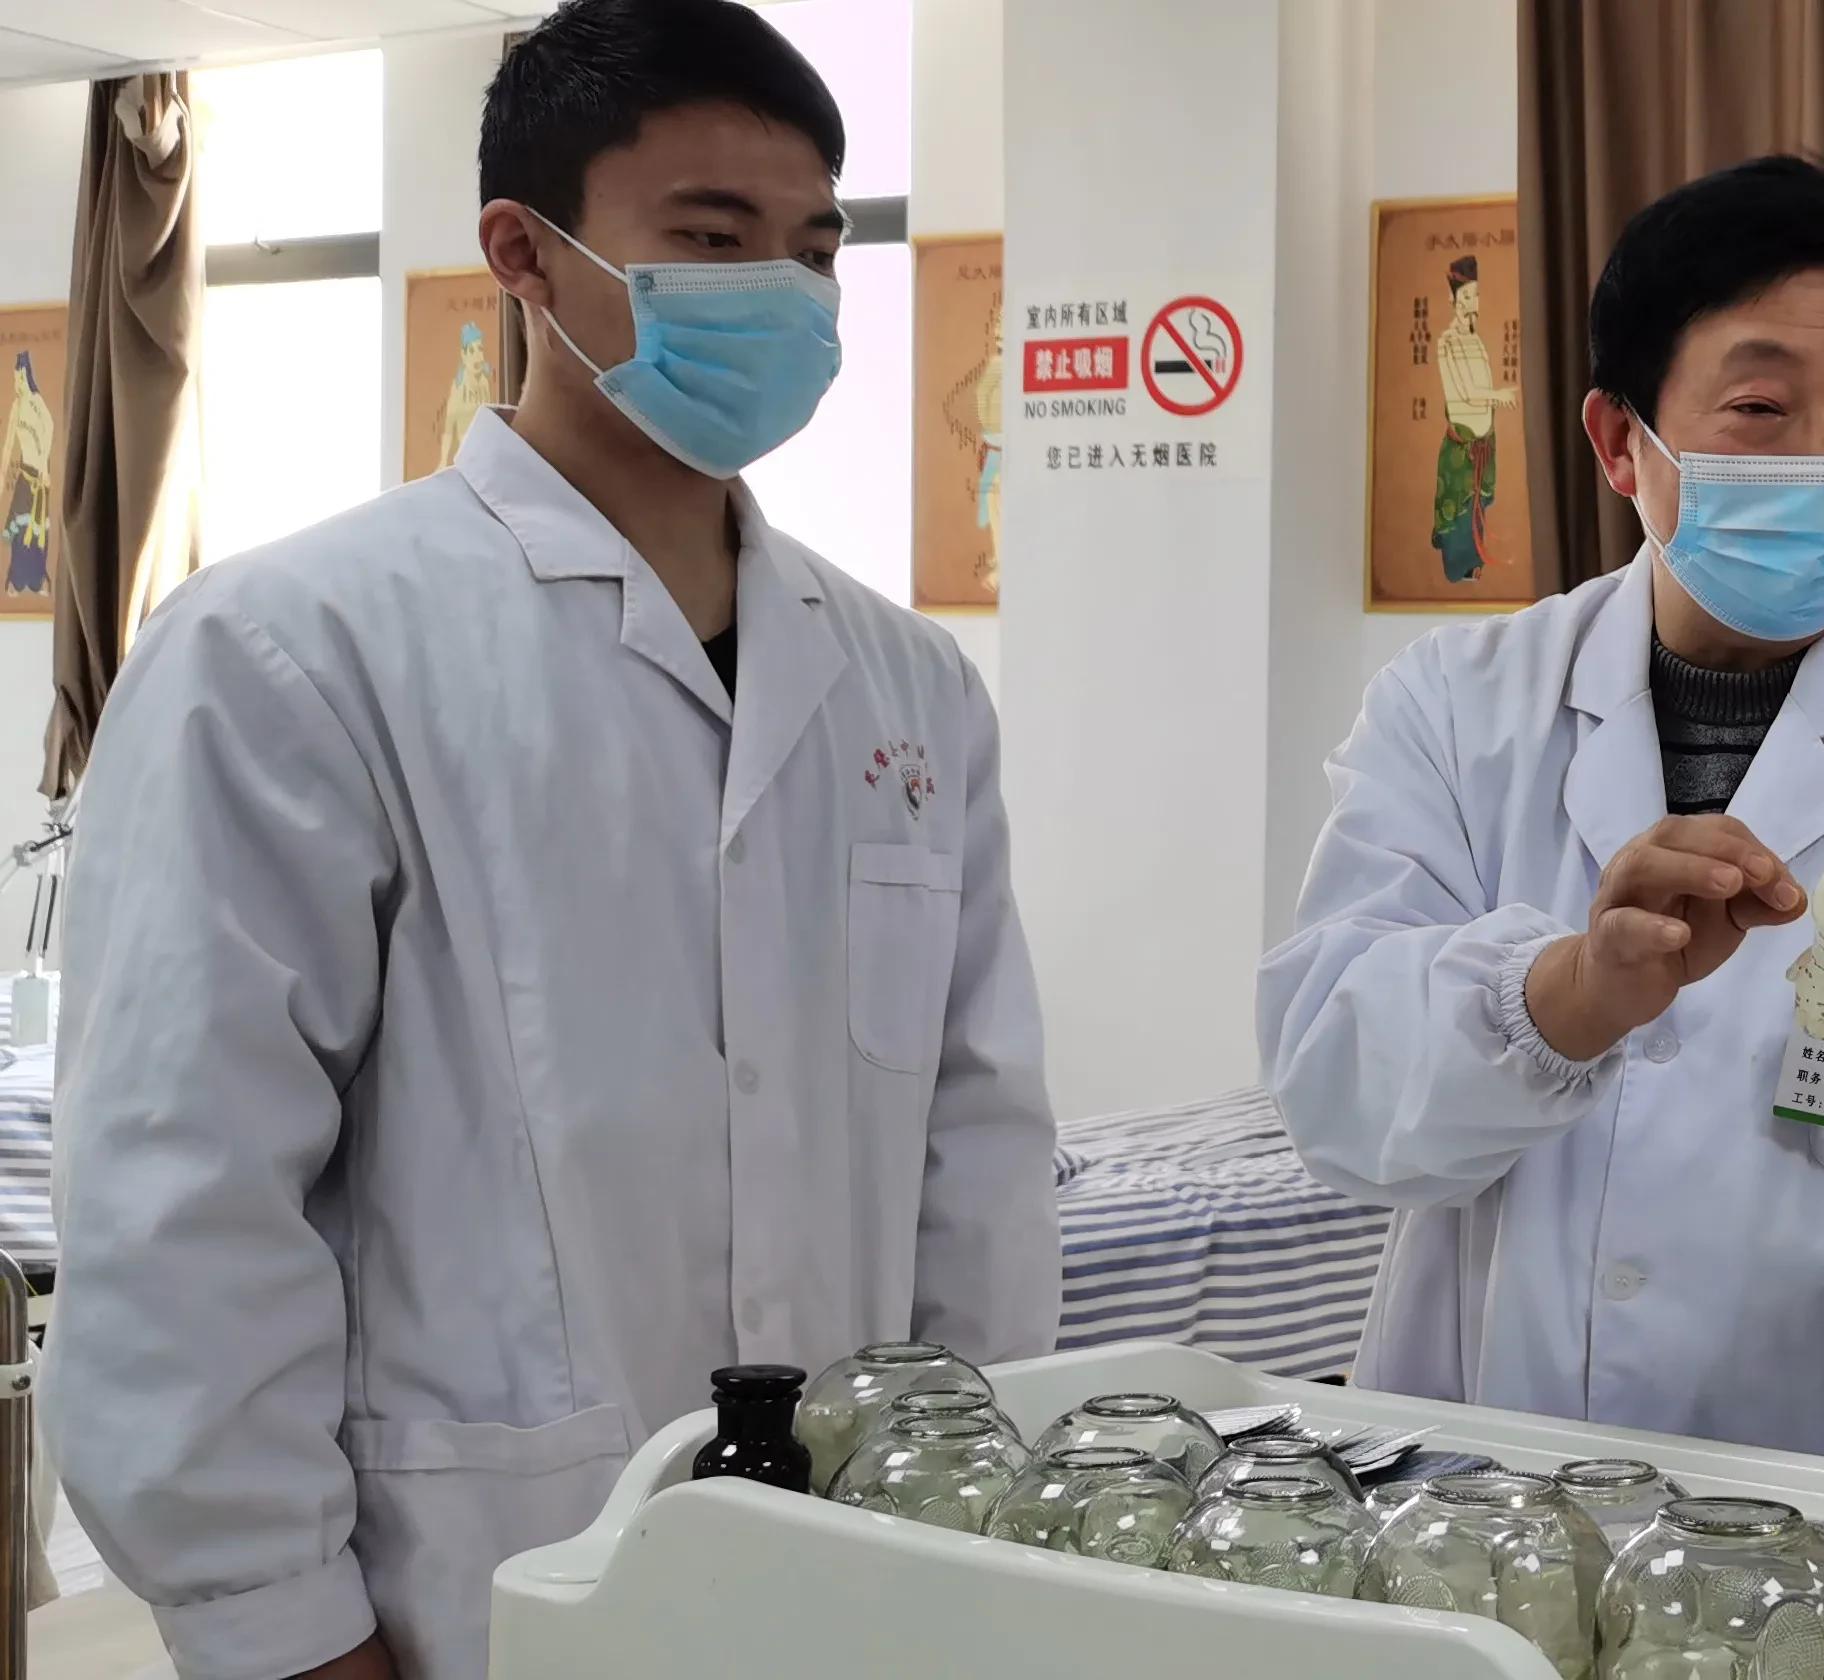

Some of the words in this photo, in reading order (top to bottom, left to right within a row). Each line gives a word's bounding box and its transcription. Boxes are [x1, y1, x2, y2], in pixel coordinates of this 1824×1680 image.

[1026, 301, 1128, 330] 室内所有区域
[1034, 346, 1114, 380] 禁止吸烟
[1024, 401, 1047, 419] NO
[1051, 398, 1127, 418] SMOKING
[1046, 442, 1218, 470] 您已进入无烟医院
